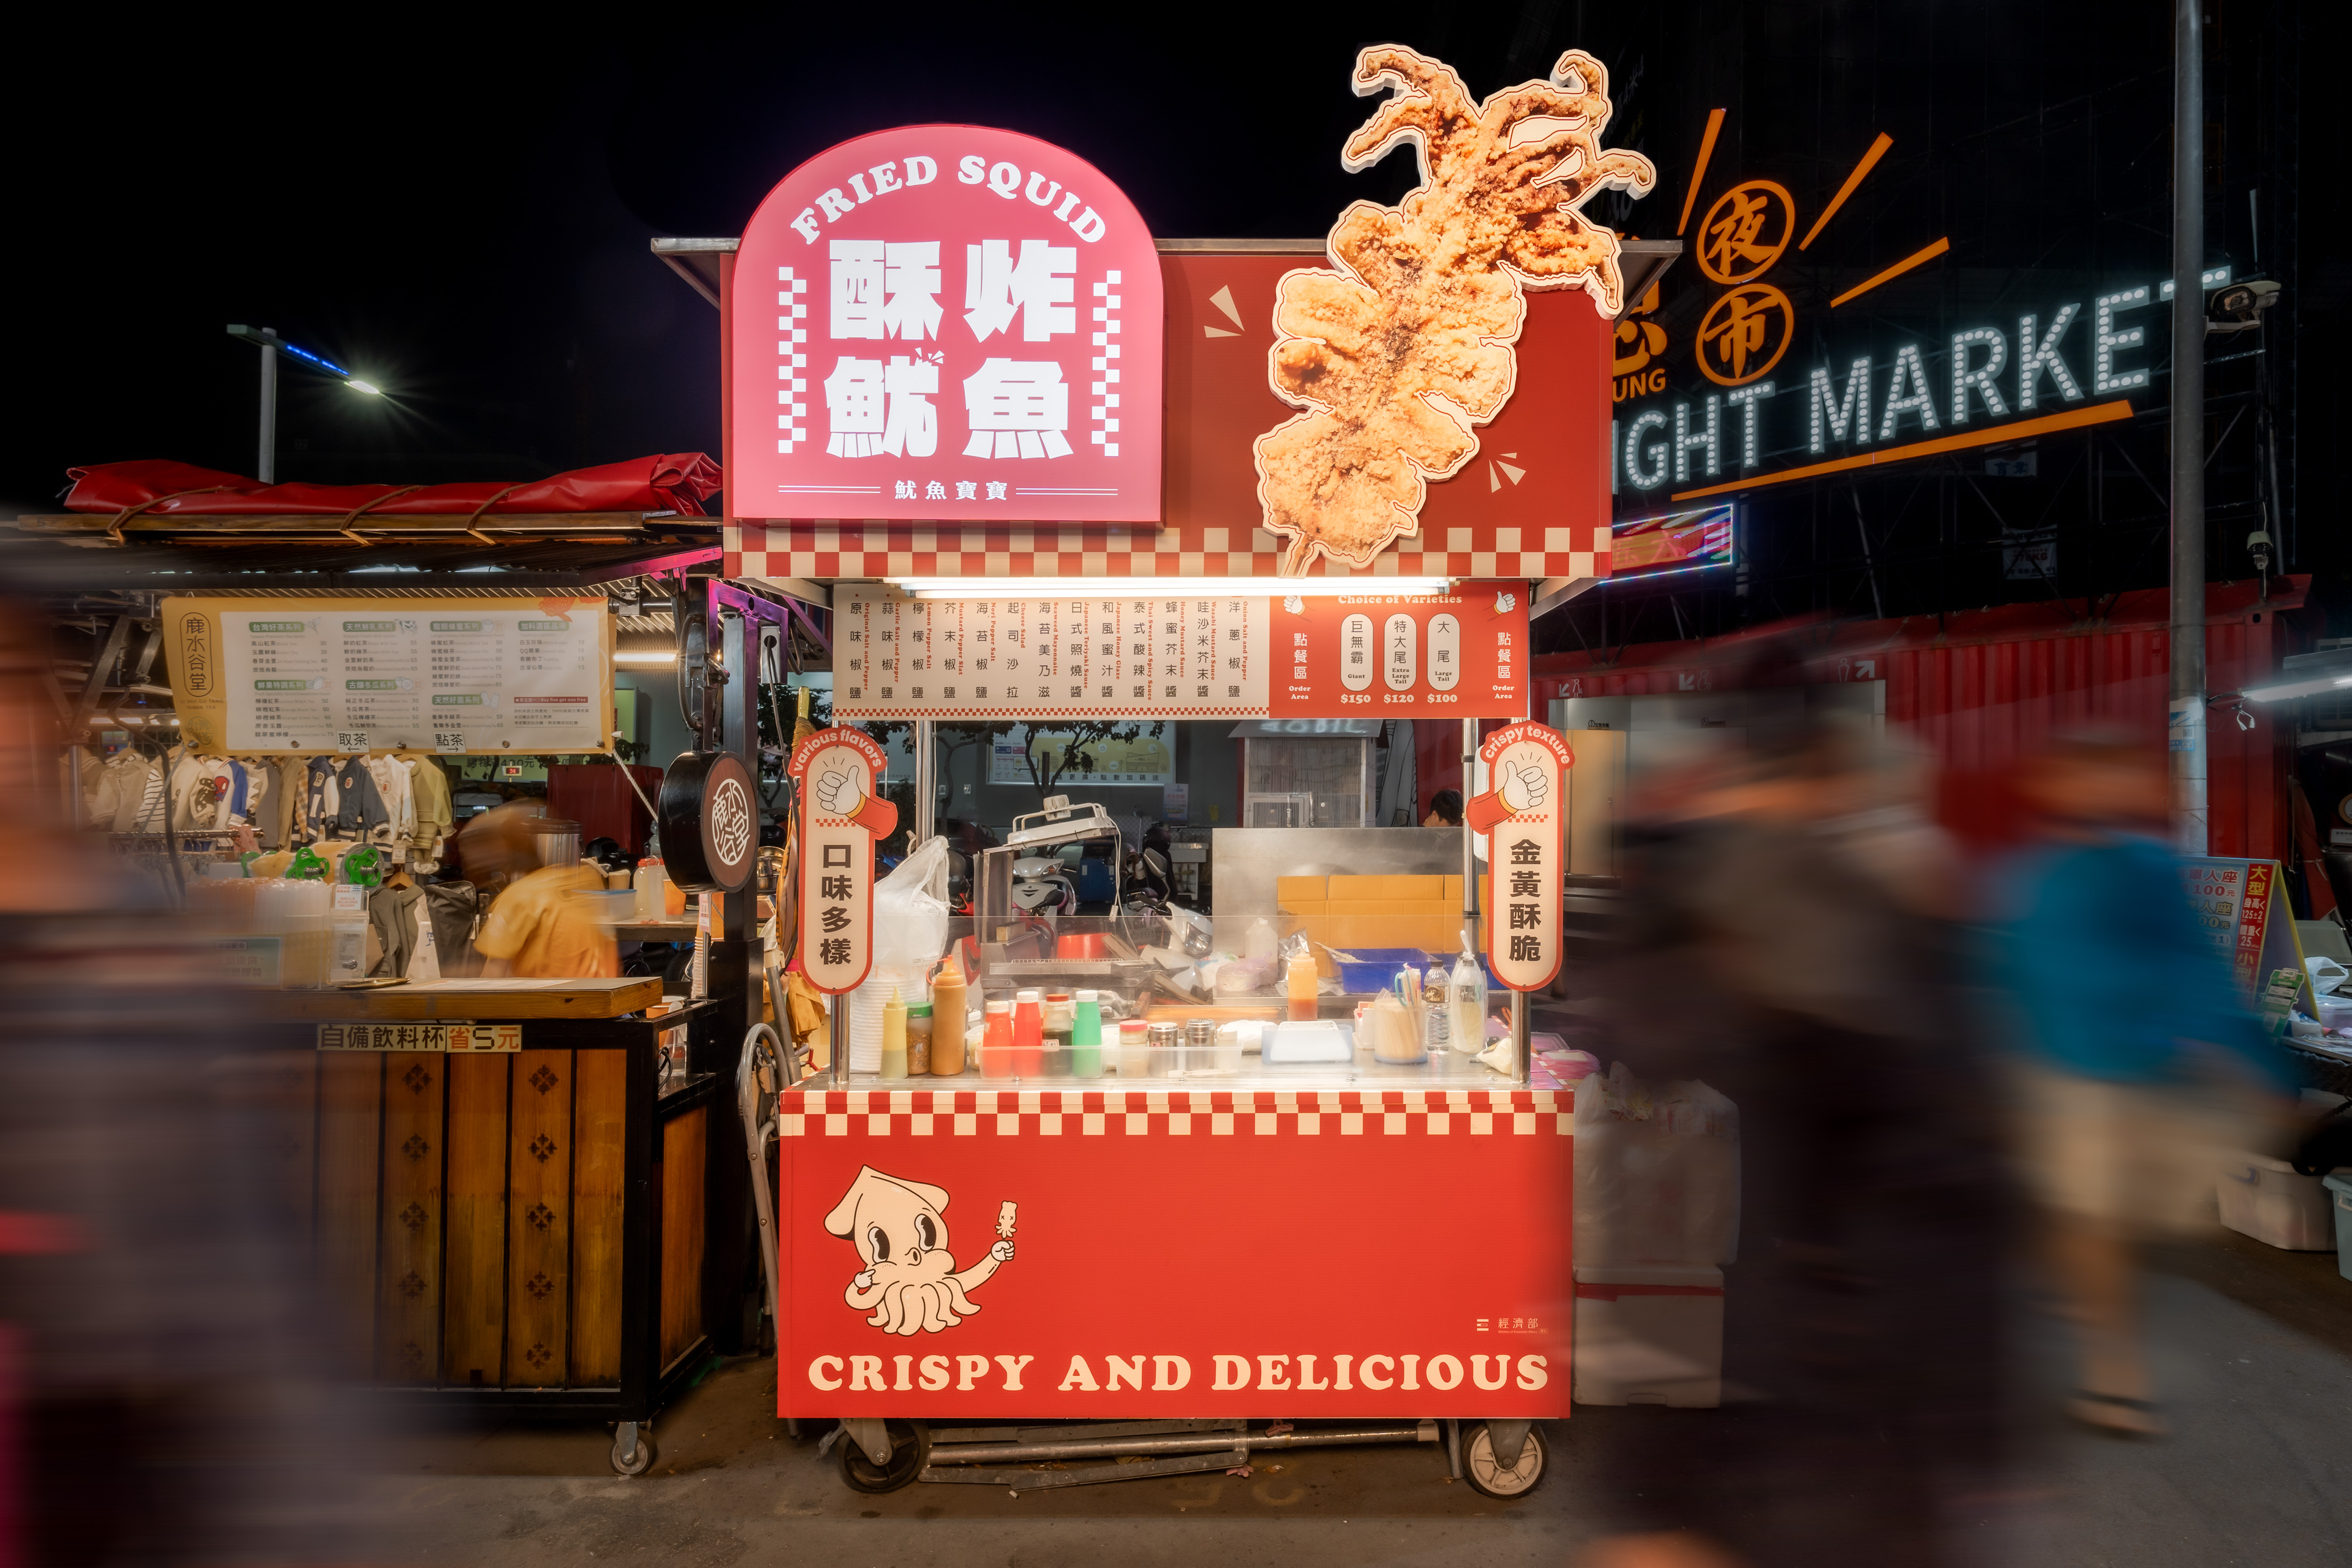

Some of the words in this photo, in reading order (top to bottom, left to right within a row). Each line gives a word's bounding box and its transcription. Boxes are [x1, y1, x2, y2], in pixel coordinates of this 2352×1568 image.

[790, 156, 938, 245] FRIED
[958, 155, 1106, 243] SQUID
[829, 239, 1077, 343] 酥炸
[1703, 191, 1784, 379] 夜市
[824, 355, 1074, 459] 魷魚
[894, 480, 1008, 501] 魷魚寶寶
[1338, 595, 1382, 604] Choice
[1386, 595, 1399, 604] of
[1403, 595, 1462, 604] Varieties
[186, 617, 207, 690] 鹿水谷堂
[850, 603, 862, 698] 原味椒鹽
[882, 602, 894, 698] 蒜味椒鹽
[912, 602, 924, 698] 檸檬椒鹽
[944, 602, 956, 698] 芥末椒鹽
[976, 602, 988, 698] 海苔椒鹽
[1007, 602, 1019, 698] 起司沙拉
[1038, 602, 1050, 698] 海苔美乃滋
[1070, 602, 1082, 697] 日式照燒醬
[1102, 602, 1113, 697] 和風蜜汁醬
[1133, 602, 1145, 697] 泰式酸辣醬
[1165, 601, 1177, 697] 蜂蜜芥末醬
[1197, 601, 1209, 697] 哇沙米芥末醬
[1229, 601, 1240, 697] 洋蔥椒鹽
[1294, 633, 1307, 679] 點餐區
[1351, 621, 1363, 664] 巨無霸
[1394, 620, 1406, 663] 特大尾
[1438, 621, 1450, 663] 大尾
[1498, 632, 1511, 678] 點餐區
[1341, 694, 1371, 704] $150
[1383, 694, 1414, 704] $120
[1427, 693, 1457, 703] $100
[339, 733, 367, 746] 取茶
[435, 733, 463, 746] 點茶
[794, 732, 838, 772] various
[840, 729, 881, 767] flavors
[1486, 727, 1524, 758] crispy
[1527, 725, 1570, 764] texture
[819, 844, 853, 965] 口味多樣
[1509, 839, 1542, 962] 金黃酥脆
[2247, 866, 2267, 896] 大型
[2240, 937, 2251, 947] 25
[1498, 1318, 1538, 1329] 經濟部
[808, 1355, 1034, 1391] CRISPY
[1058, 1355, 1192, 1391] AND
[1211, 1354, 1548, 1391] DELICIOUS
